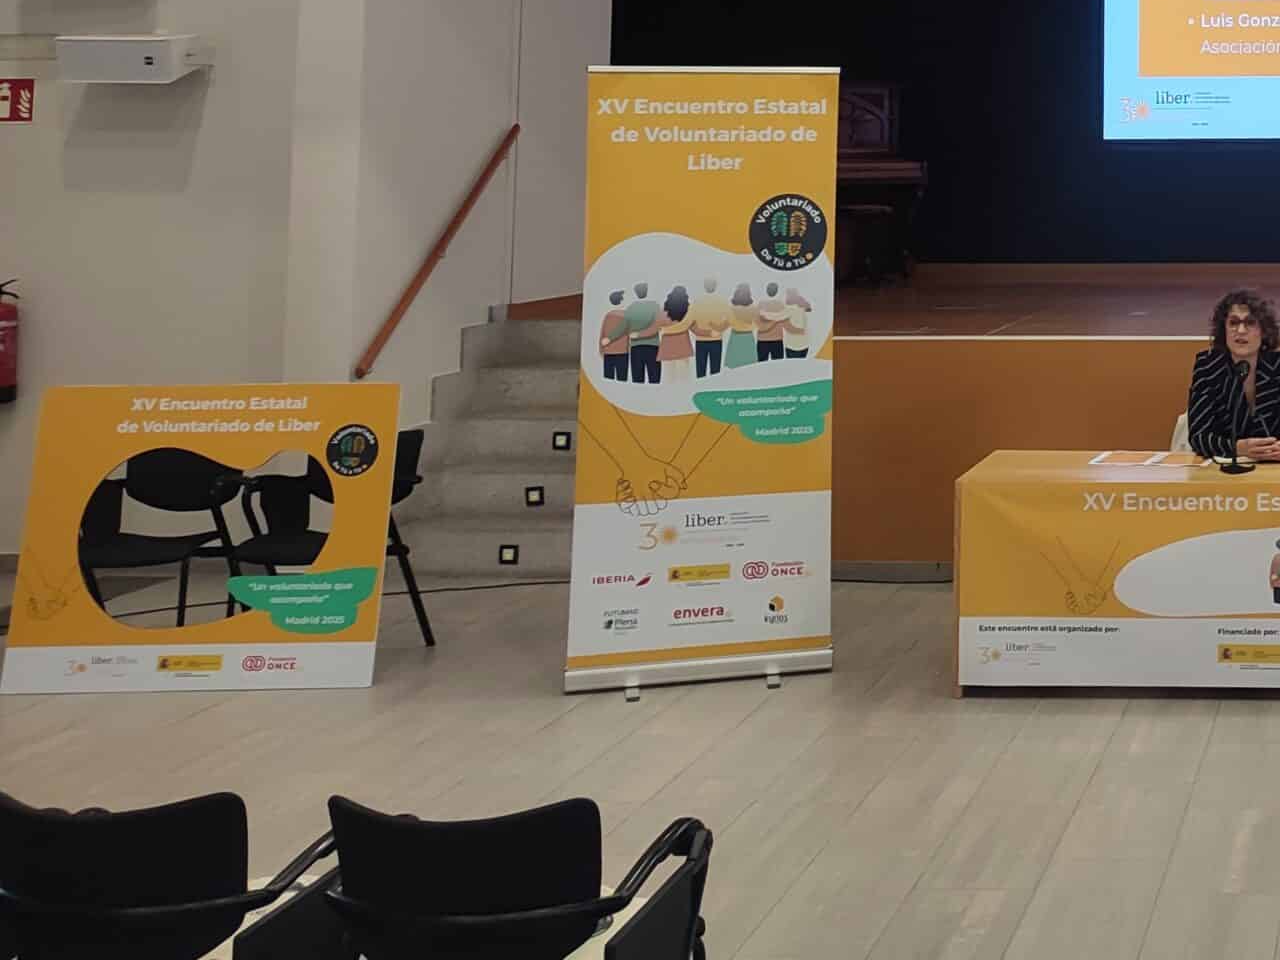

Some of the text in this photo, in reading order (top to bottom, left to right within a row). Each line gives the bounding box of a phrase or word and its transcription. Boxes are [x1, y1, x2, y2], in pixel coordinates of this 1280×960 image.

[1201, 14, 1234, 28] Luis
[597, 97, 827, 115] XV Encuentro Estatal
[610, 126, 818, 142] de Voluntariado de
[687, 153, 744, 171] Liber
[755, 197, 821, 223] Voluntariado
[131, 396, 308, 411] XV Encuentro Estatal
[117, 418, 320, 433] de Voluntariado de Liber
[755, 426, 789, 436] Madrid
[1083, 493, 1116, 511] XV
[1122, 492, 1249, 511] Encuentro
[771, 567, 804, 577] ONCE
[592, 574, 636, 585] IBERIA
[673, 605, 725, 619] envera
[285, 615, 320, 624] Madrid
[979, 624, 996, 632] Este
[998, 624, 1039, 632] encuentro
[1040, 624, 1057, 632] está
[1058, 624, 1103, 633] organizado
[1217, 627, 1261, 636] Financiado
[267, 661, 297, 671] ONCE
